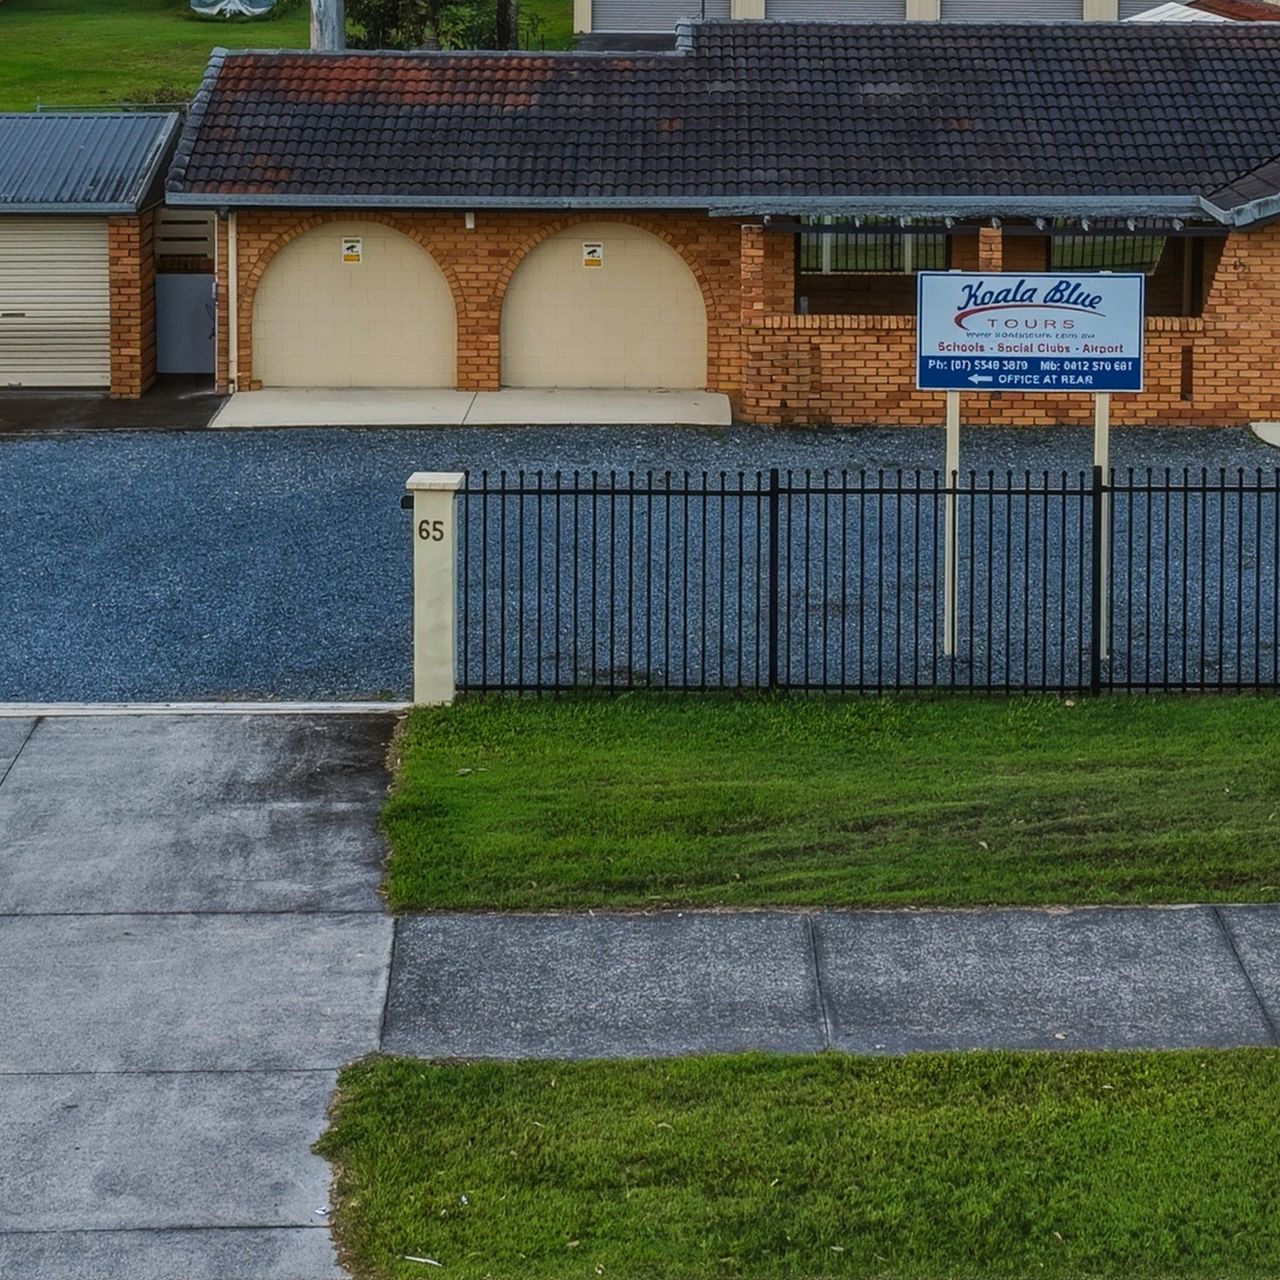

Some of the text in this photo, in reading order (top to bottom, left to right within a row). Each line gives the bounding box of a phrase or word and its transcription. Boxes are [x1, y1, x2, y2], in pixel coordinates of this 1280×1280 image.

[957, 279, 1103, 310] Koala Blue
[987, 319, 1075, 329] TOURS
[938, 341, 985, 352] Schools
[997, 342, 1034, 353] Social
[1037, 343, 1071, 353] Clubs
[1082, 343, 1124, 354] Airport
[928, 359, 948, 370] Ph:
[998, 374, 1094, 385] OFFICE AT REAR
[418, 519, 445, 542] 65
